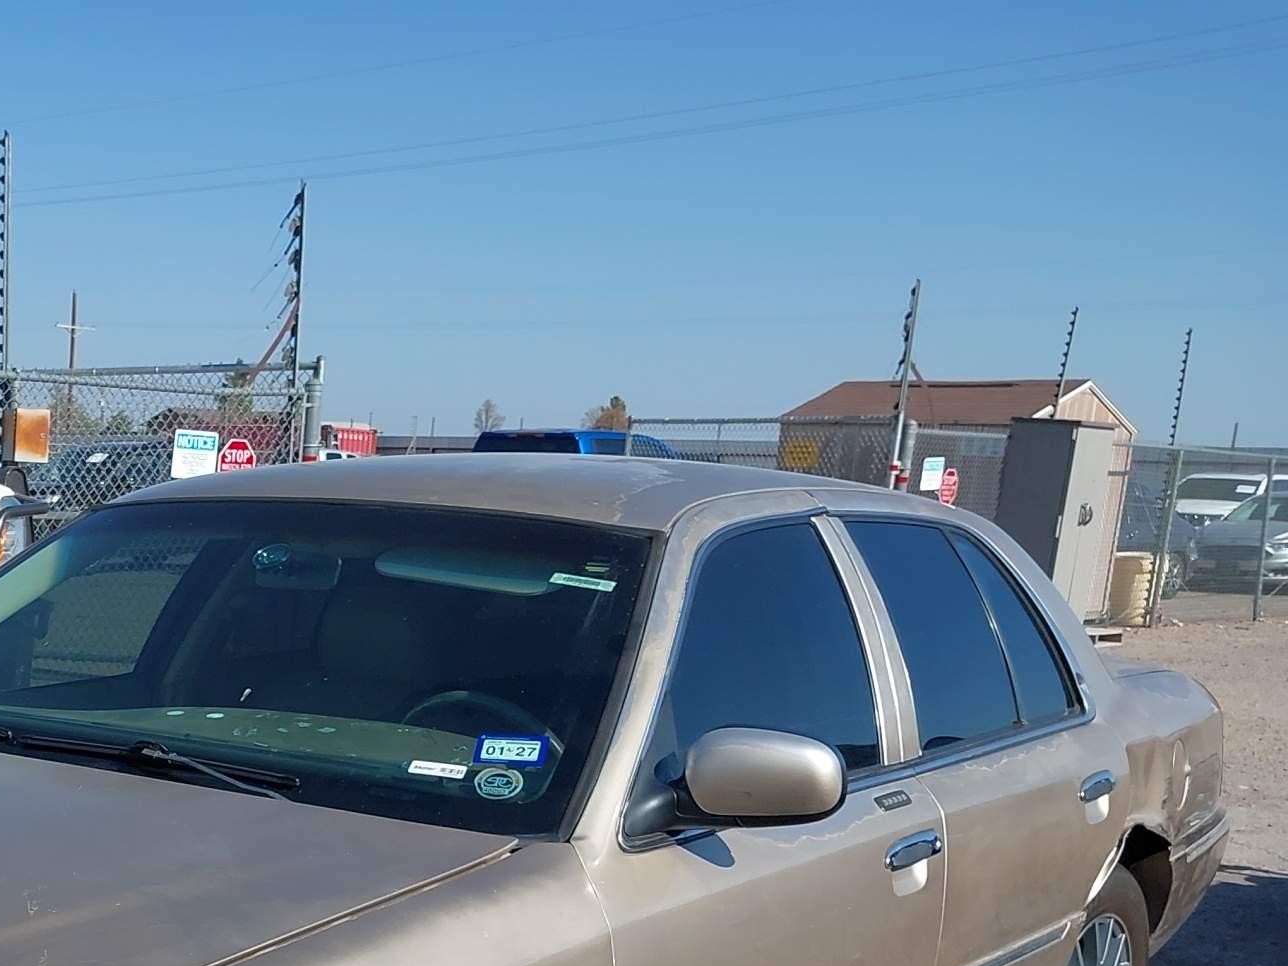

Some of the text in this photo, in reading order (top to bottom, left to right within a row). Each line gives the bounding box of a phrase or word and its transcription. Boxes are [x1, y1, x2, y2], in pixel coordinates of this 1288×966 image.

[178, 435, 215, 449] NOTICE
[224, 449, 251, 464] STOP
[485, 745, 537, 758] 01 27
